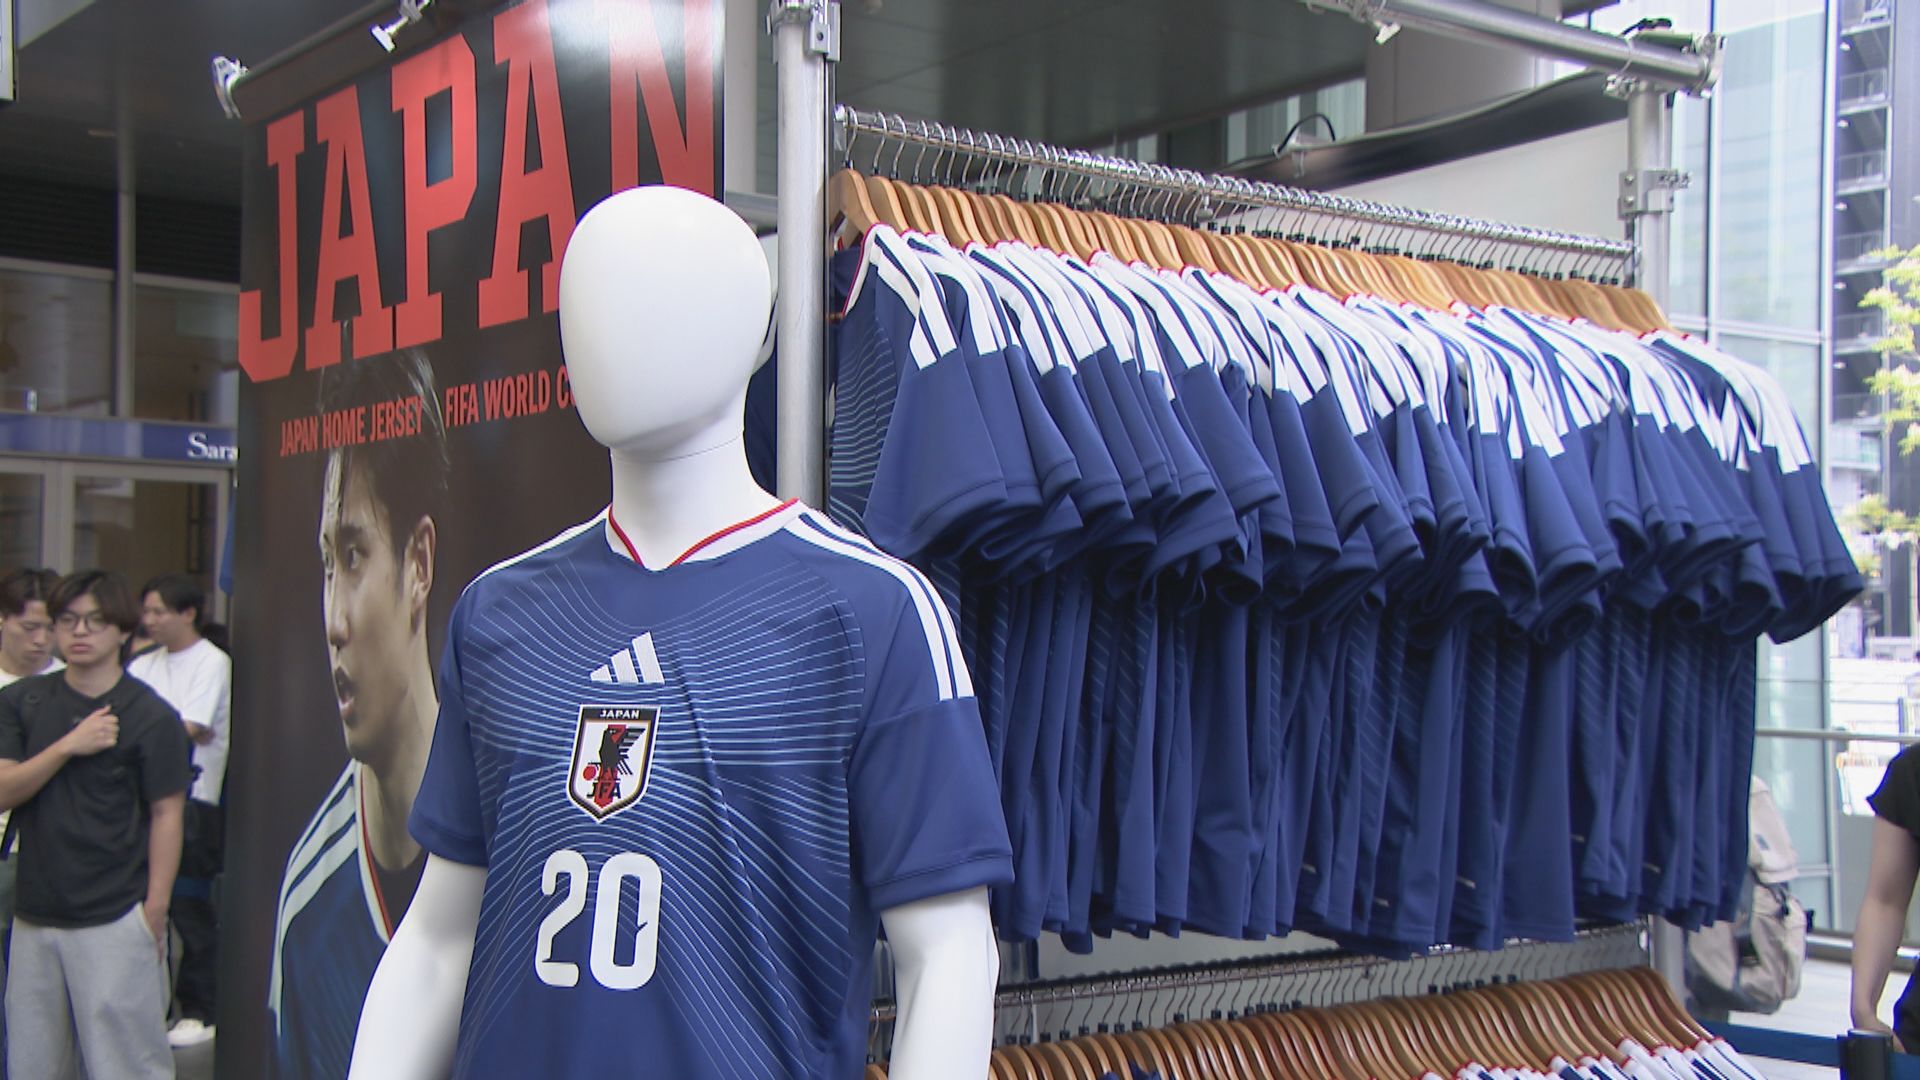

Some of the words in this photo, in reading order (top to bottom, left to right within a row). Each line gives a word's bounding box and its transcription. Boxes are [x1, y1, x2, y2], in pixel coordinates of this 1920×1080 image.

[237, 0, 715, 383] JAPAN
[280, 415, 319, 457] JAPAN
[322, 406, 367, 449] HOME
[369, 395, 425, 442] JERSEY
[445, 383, 480, 429] FIFA
[483, 369, 551, 421] WORLD
[556, 364, 577, 409] C
[600, 709, 640, 719] JAPAN
[587, 782, 621, 799] JFA
[535, 849, 662, 990] 20
